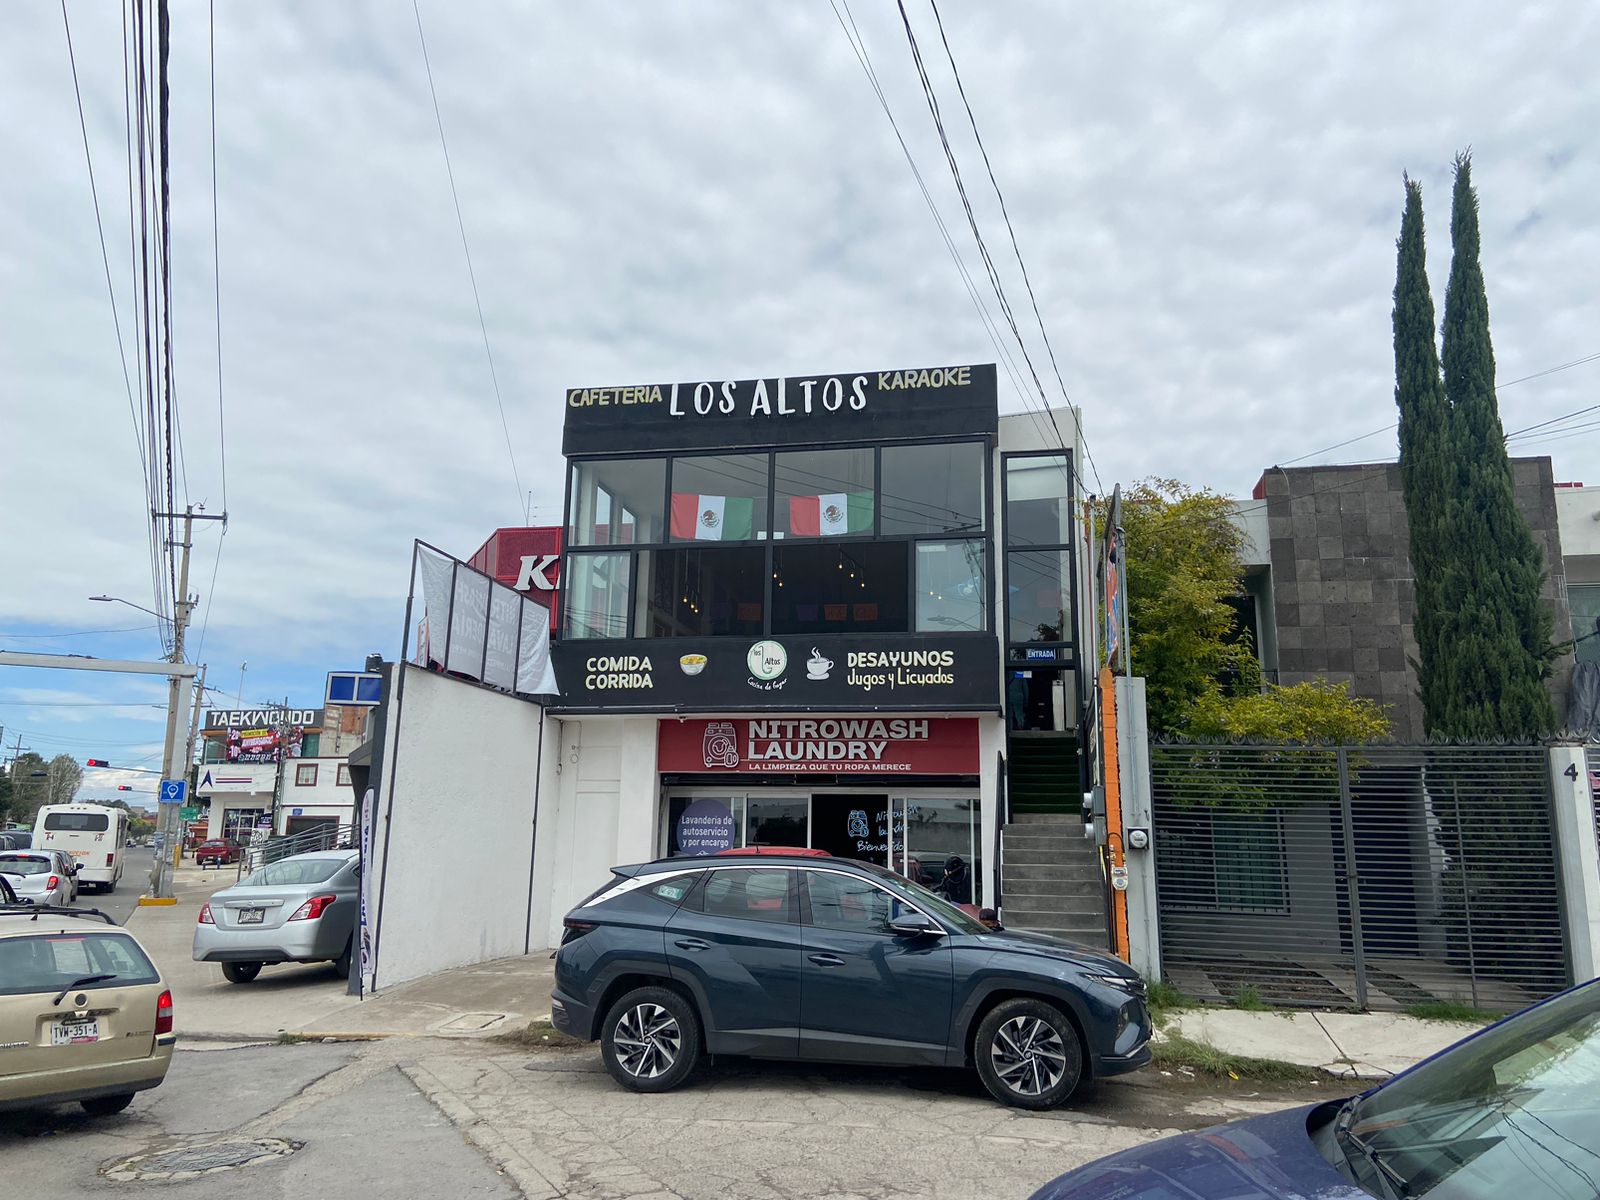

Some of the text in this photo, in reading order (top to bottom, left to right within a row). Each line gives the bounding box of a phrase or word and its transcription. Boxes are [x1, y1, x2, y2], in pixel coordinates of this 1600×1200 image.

[877, 366, 972, 391] KARAOKE
[569, 385, 662, 408] CAFETERIA
[669, 375, 869, 416] LOS ALTOS
[764, 657, 781, 666] Altos
[847, 650, 955, 668] DESAYUNOS
[1027, 650, 1054, 658] ENTRADA
[586, 655, 653, 673] COMIDA
[585, 672, 654, 690] CORRIDA
[847, 667, 955, 692] Jugos y Licuados
[748, 720, 929, 739] NITROWASH
[748, 741, 888, 760] LAUNDRY
[749, 763, 912, 771] LA LIMPIEZA QUE TU ROPA MERECE
[1564, 762, 1578, 782] 4
[723, 815, 733, 825] de
[682, 826, 729, 836] autoservicio
[682, 839, 729, 849] y por encargo
